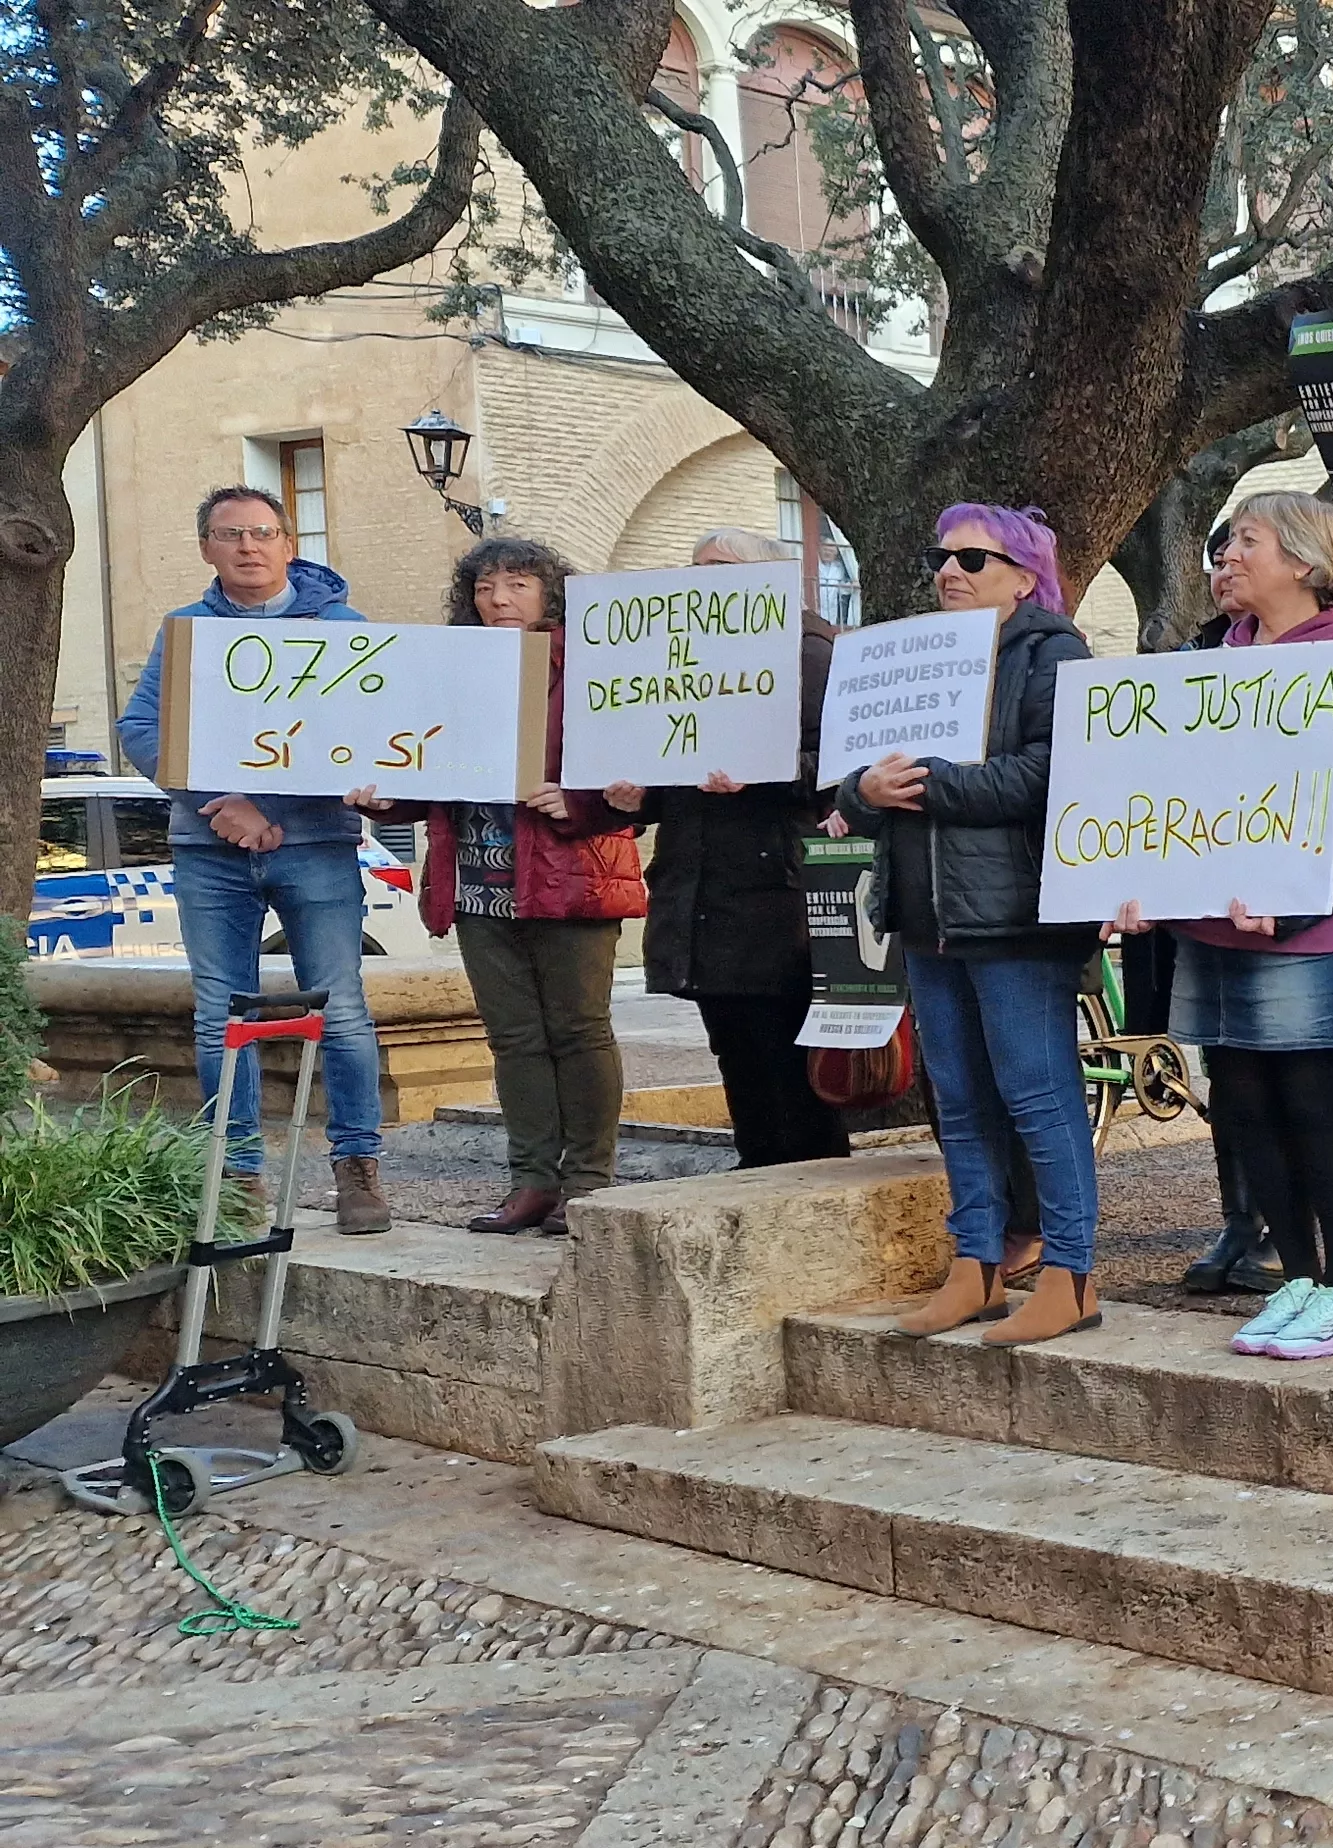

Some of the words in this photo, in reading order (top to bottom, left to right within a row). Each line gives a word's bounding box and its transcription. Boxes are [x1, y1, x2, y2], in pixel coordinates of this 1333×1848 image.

[1303, 399, 1320, 410] POR
[583, 584, 786, 646] COOPERACIÓN
[667, 636, 698, 670] AL
[861, 641, 897, 662] POR
[902, 632, 957, 654] UNOS
[225, 633, 398, 704] 0,7%
[837, 658, 987, 696] PRESUPUESTOS
[588, 669, 774, 711] DESARROLLO
[848, 691, 940, 722] SOCIALES
[948, 690, 962, 707] Y
[1087, 679, 1167, 742] POR
[240, 720, 303, 770] SÍ
[662, 712, 698, 757] YA
[845, 720, 959, 752] SOLIDARIOS
